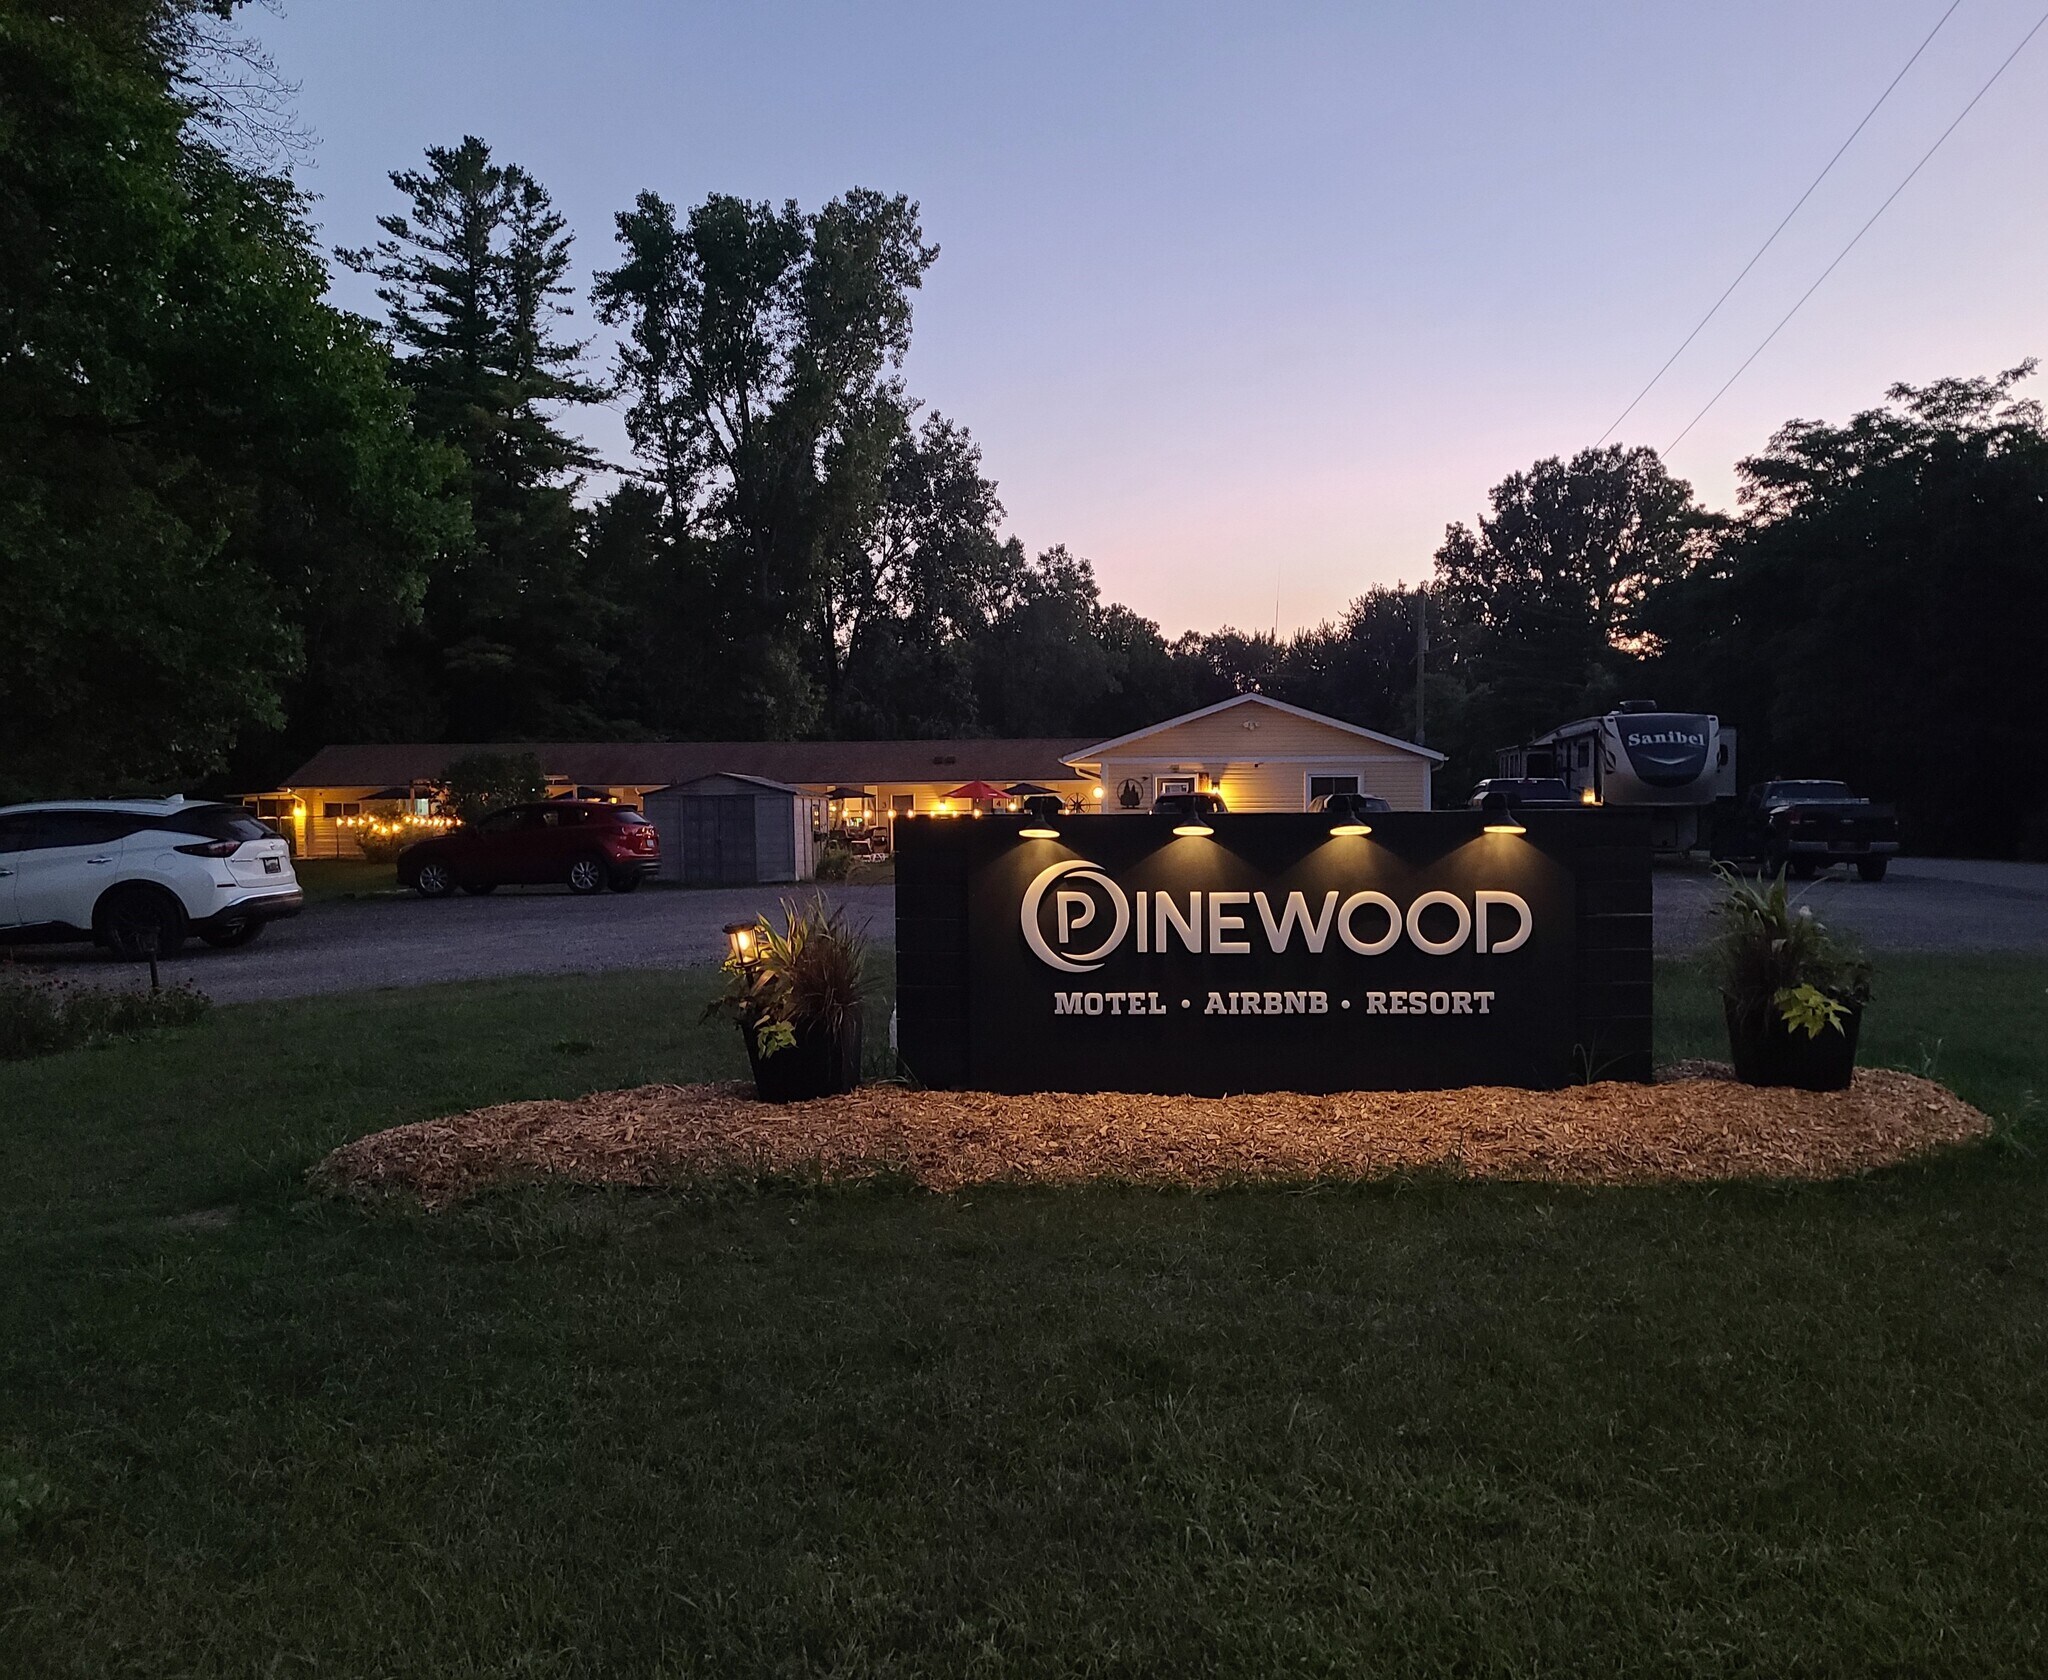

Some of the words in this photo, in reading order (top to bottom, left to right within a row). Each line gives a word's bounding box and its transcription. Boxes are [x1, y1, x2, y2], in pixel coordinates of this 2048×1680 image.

[1628, 731, 1705, 746] Sanibel
[1022, 861, 1533, 971] PINEWOOD
[1054, 991, 1167, 1016] MOTEL
[1204, 991, 1329, 1015] AIRBNB
[1366, 990, 1496, 1015] RESORT
